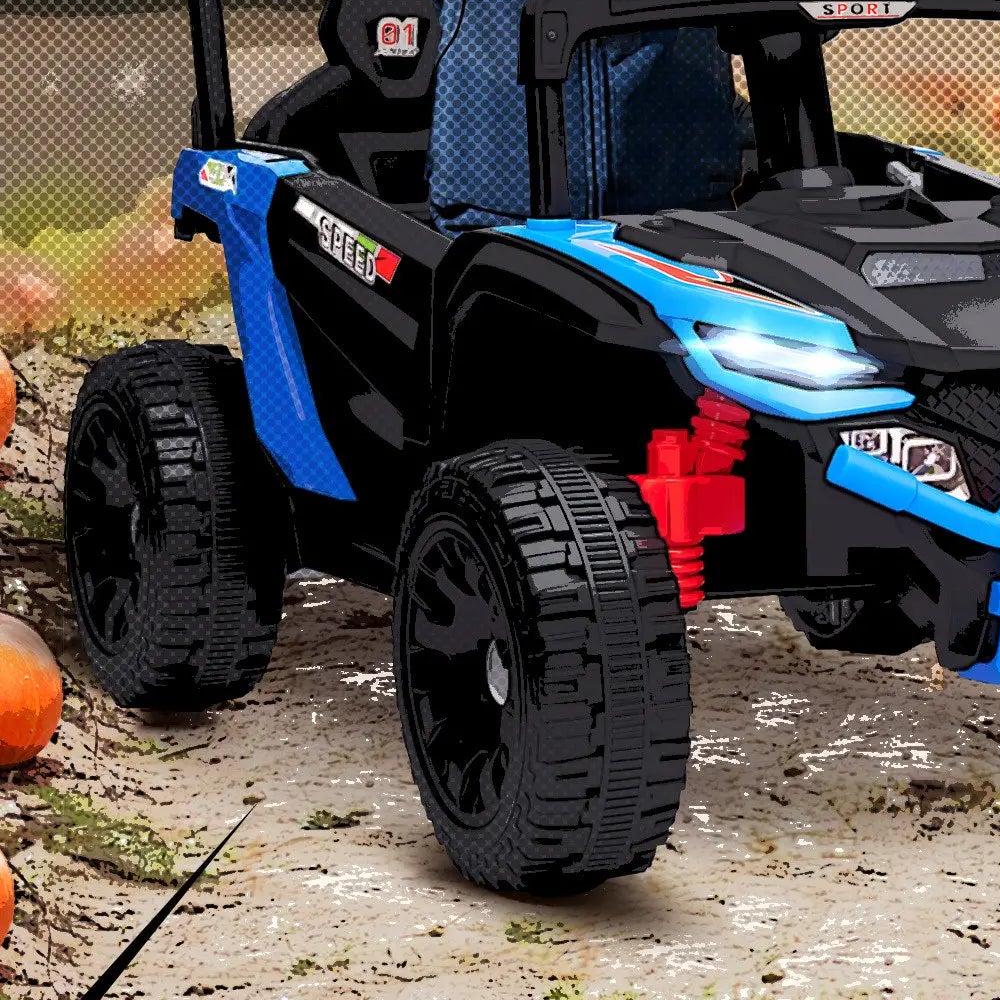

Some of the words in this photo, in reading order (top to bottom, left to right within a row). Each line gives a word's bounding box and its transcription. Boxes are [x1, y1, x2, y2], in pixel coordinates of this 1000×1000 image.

[822, 3, 890, 15] SPORT
[381, 23, 414, 46] 01
[318, 214, 377, 285] SPEED
